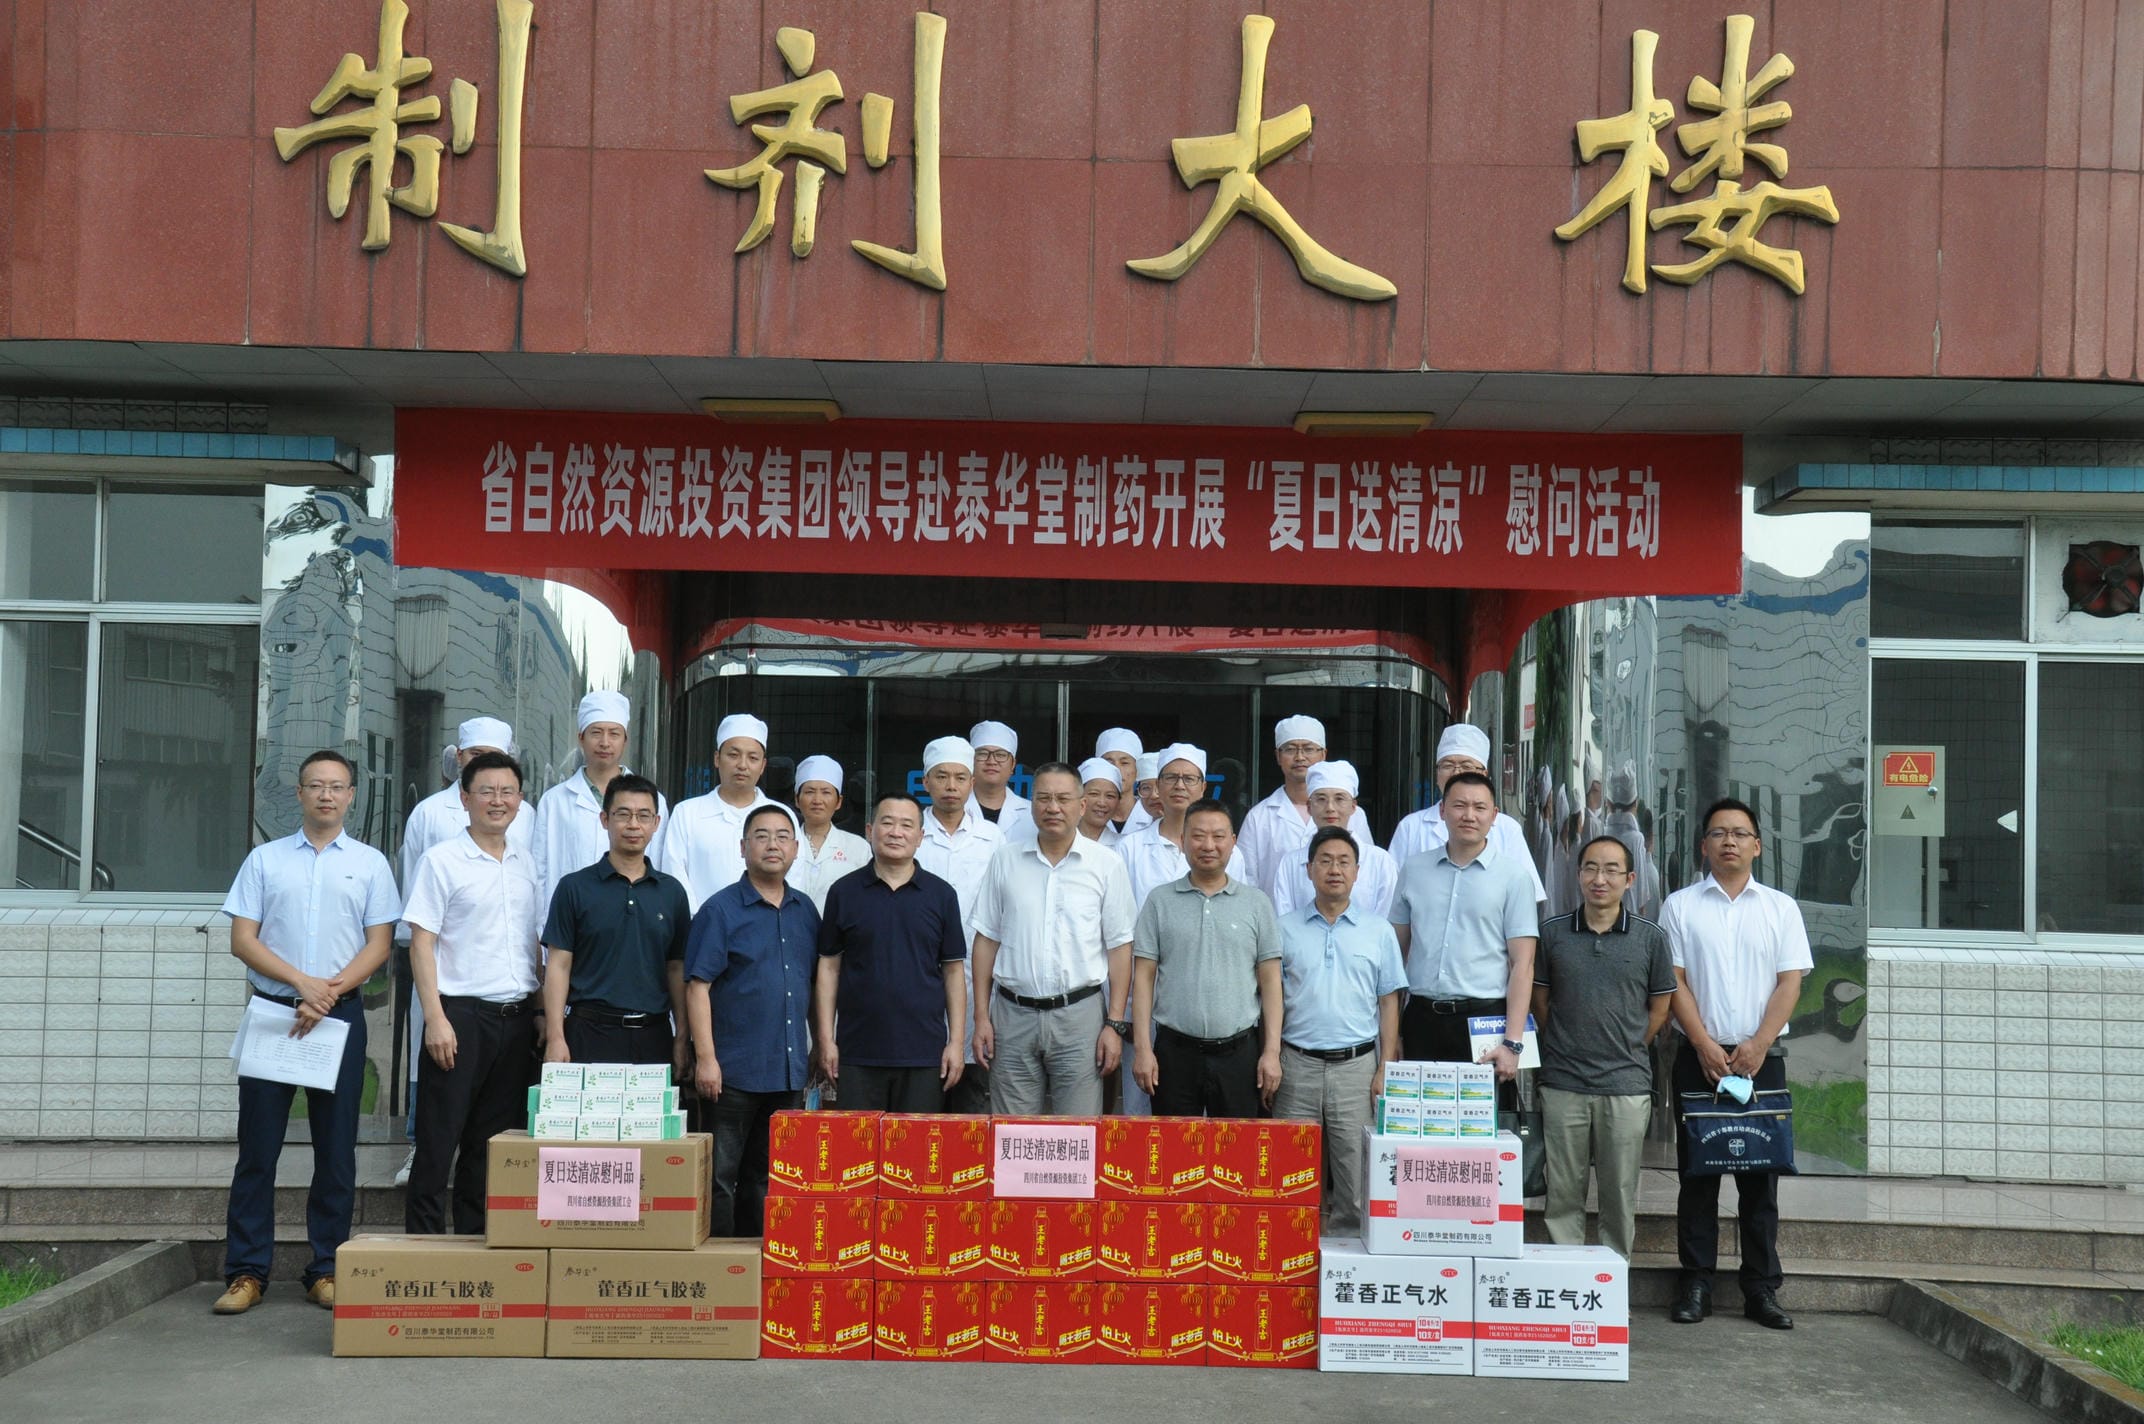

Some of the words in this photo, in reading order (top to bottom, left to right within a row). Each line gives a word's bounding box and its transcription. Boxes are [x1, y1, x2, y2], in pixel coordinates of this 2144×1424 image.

[272, 0, 1840, 302] 制剂大楼
[1889, 774, 1929, 783] 有电危险
[818, 1139, 829, 1171] 王老吉
[928, 1142, 939, 1174] 王老吉
[1000, 1137, 1090, 1162] 夏日送清凉慰问品
[1148, 1143, 1159, 1175] 王老吉
[1258, 1145, 1269, 1177] 王老吉
[543, 1160, 635, 1185] 夏日送清凉慰问品
[772, 1159, 803, 1180] 怕上火
[882, 1161, 913, 1183] 怕上火
[1103, 1162, 1134, 1184] 怕上火
[1212, 1164, 1244, 1186] 怕上火
[1402, 1159, 1494, 1185] 夏日送清凉慰问品
[814, 1219, 824, 1251] 王老吉
[925, 1223, 935, 1255] 王老吉
[1035, 1224, 1046, 1256] 王老吉
[1146, 1225, 1157, 1257] 王老吉
[1257, 1229, 1268, 1261] 王老吉
[1413, 1231, 1492, 1241] 四川泰华堂制药有限公司
[768, 1239, 799, 1261] 怕上火
[879, 1243, 910, 1264] 怕上火
[989, 1243, 1021, 1265] 怕上火
[1100, 1244, 1131, 1266] 怕上火
[1211, 1248, 1242, 1270] 怕上火
[385, 1280, 495, 1298] 藿香正气胶囊
[598, 1279, 707, 1299] 藿香正气胶囊
[1335, 1282, 1448, 1306] 藿香正气水
[1488, 1286, 1603, 1311] 藿香正气水
[811, 1300, 822, 1332] 王老吉
[922, 1304, 932, 1336] 王老吉
[1034, 1304, 1045, 1336] 王老吉
[1147, 1305, 1157, 1337] 王老吉
[1258, 1308, 1268, 1340] 王老吉
[405, 1327, 495, 1336] 四川泰华堂制药有限公司
[765, 1319, 796, 1341] 怕上火
[876, 1324, 907, 1345] 怕上火
[989, 1323, 1020, 1345] 怕上火
[1101, 1324, 1132, 1346] 怕上火
[1212, 1328, 1243, 1350] 怕上火
[1573, 1335, 1595, 1345] 10支/盒
